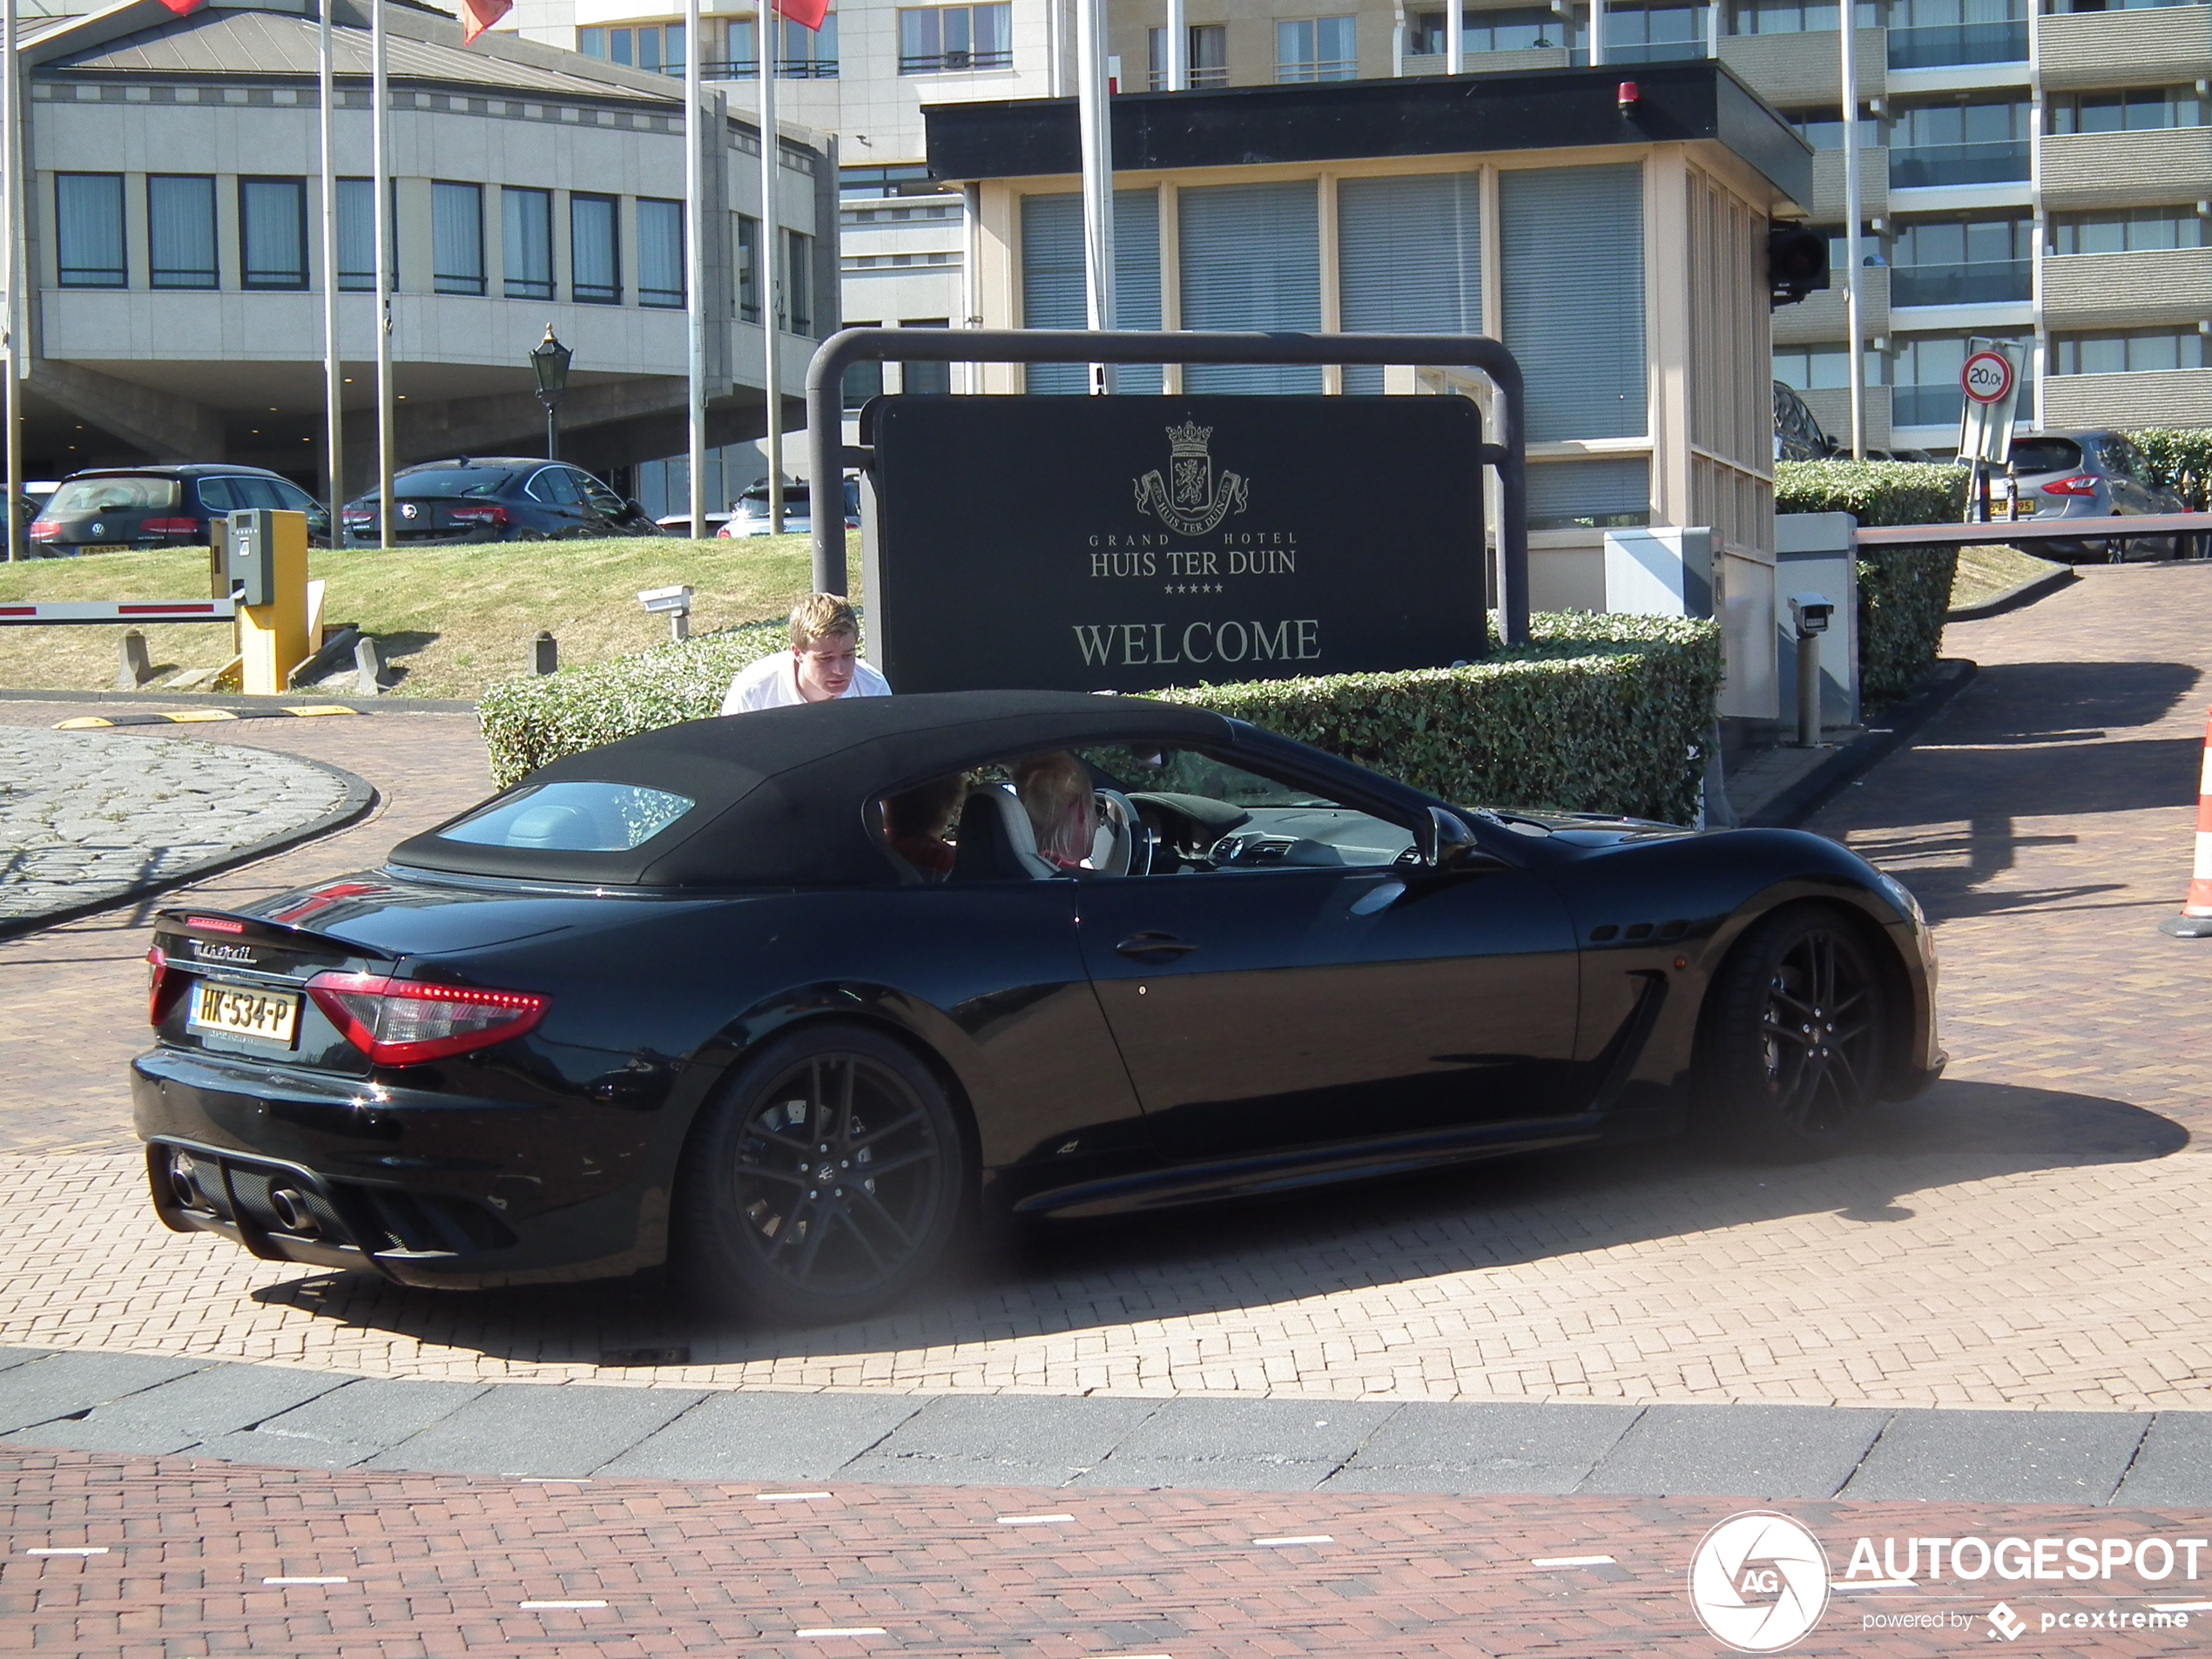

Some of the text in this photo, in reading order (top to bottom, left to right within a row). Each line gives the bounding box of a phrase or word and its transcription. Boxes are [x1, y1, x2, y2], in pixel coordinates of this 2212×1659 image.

[1158, 501, 1225, 532] HUIS TER DUIN
[1089, 532, 1297, 546] GRAND HOTEL
[1090, 550, 1297, 577] HUIS TER DUIN
[1072, 619, 1321, 666] WELCOME
[200, 988, 287, 1032] HK-534-P
